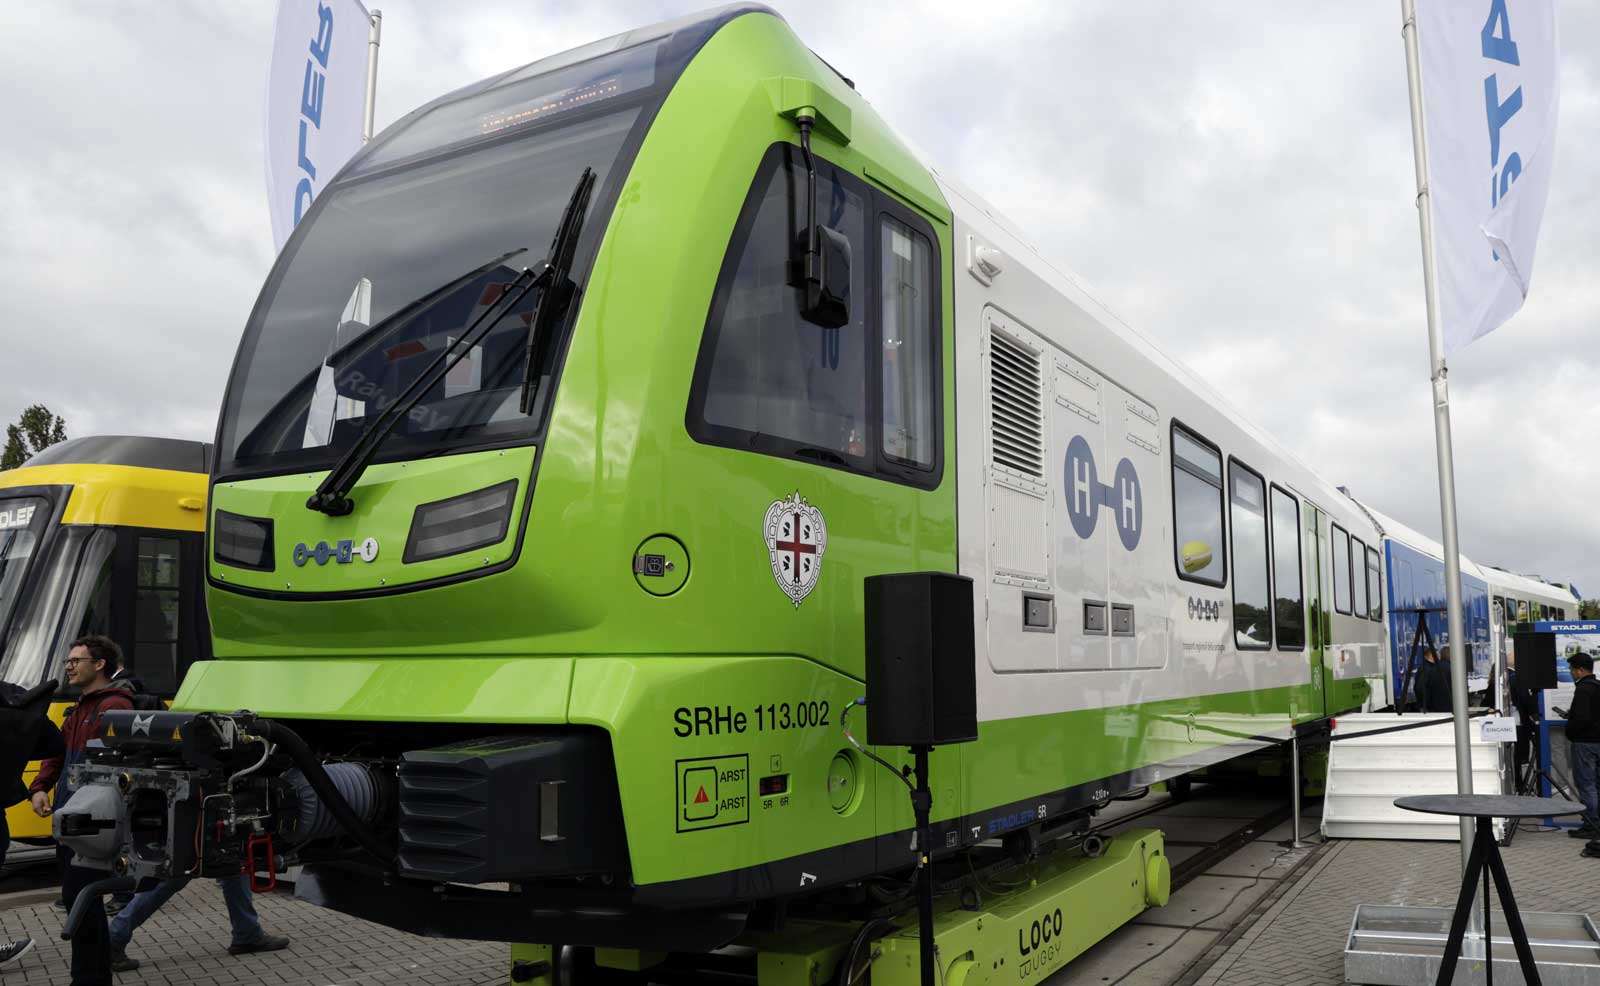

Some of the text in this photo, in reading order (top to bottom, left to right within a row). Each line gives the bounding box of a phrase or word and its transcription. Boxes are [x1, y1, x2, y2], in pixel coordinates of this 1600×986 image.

[1073, 457, 1137, 532] H H
[673, 700, 830, 738] SRHe 113.002
[720, 769, 746, 783] ARST
[720, 796, 746, 811] ARST
[763, 799, 773, 810] 5R
[988, 804, 1047, 833] STADLER 5R
[1019, 908, 1063, 956] LOCO
